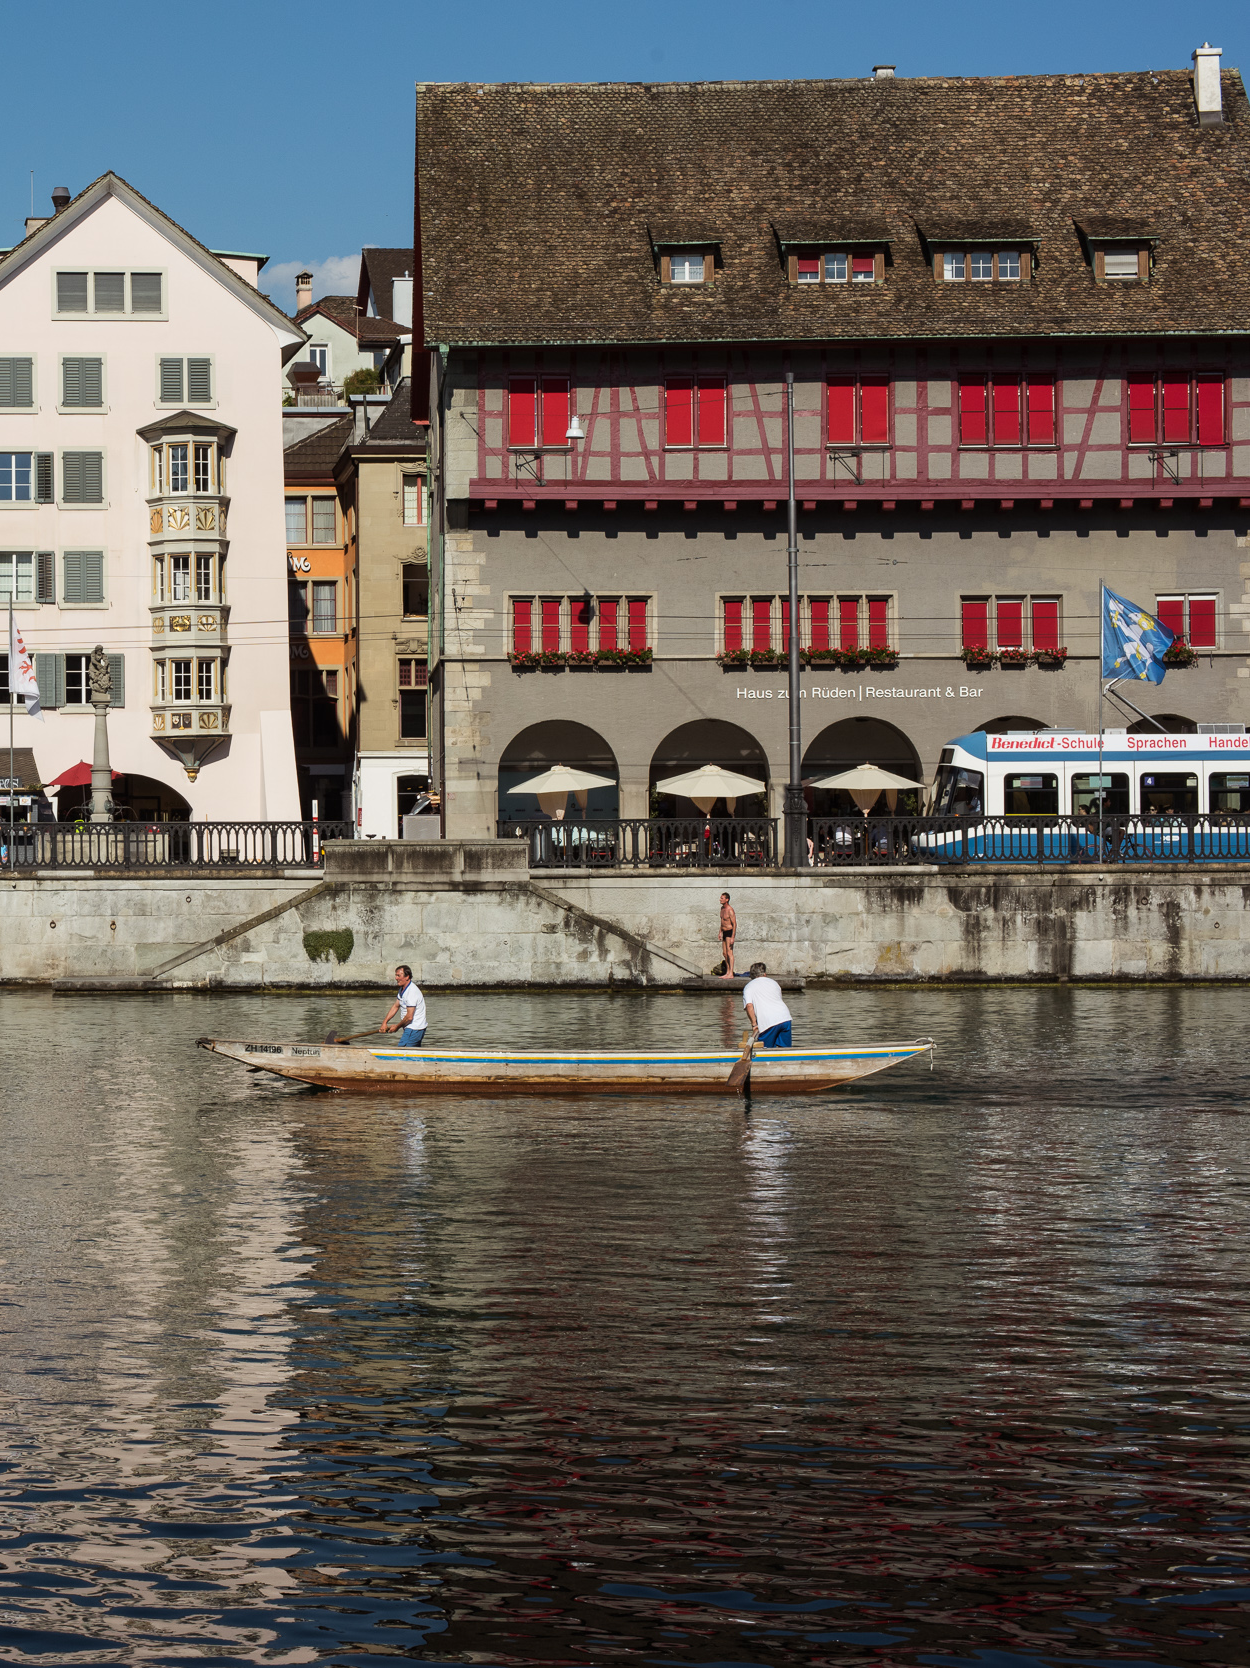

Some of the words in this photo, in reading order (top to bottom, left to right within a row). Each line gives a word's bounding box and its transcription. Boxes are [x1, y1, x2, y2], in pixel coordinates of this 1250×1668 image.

[736, 687, 773, 699] Haus
[811, 686, 856, 699] Rüden
[865, 686, 942, 698] Restaurant
[945, 686, 956, 698] &
[959, 686, 984, 698] Bar
[1127, 736, 1187, 751] Sprachen
[245, 1044, 258, 1053] ZH
[259, 1045, 282, 1054] 14196
[291, 1047, 321, 1056] Neptun
